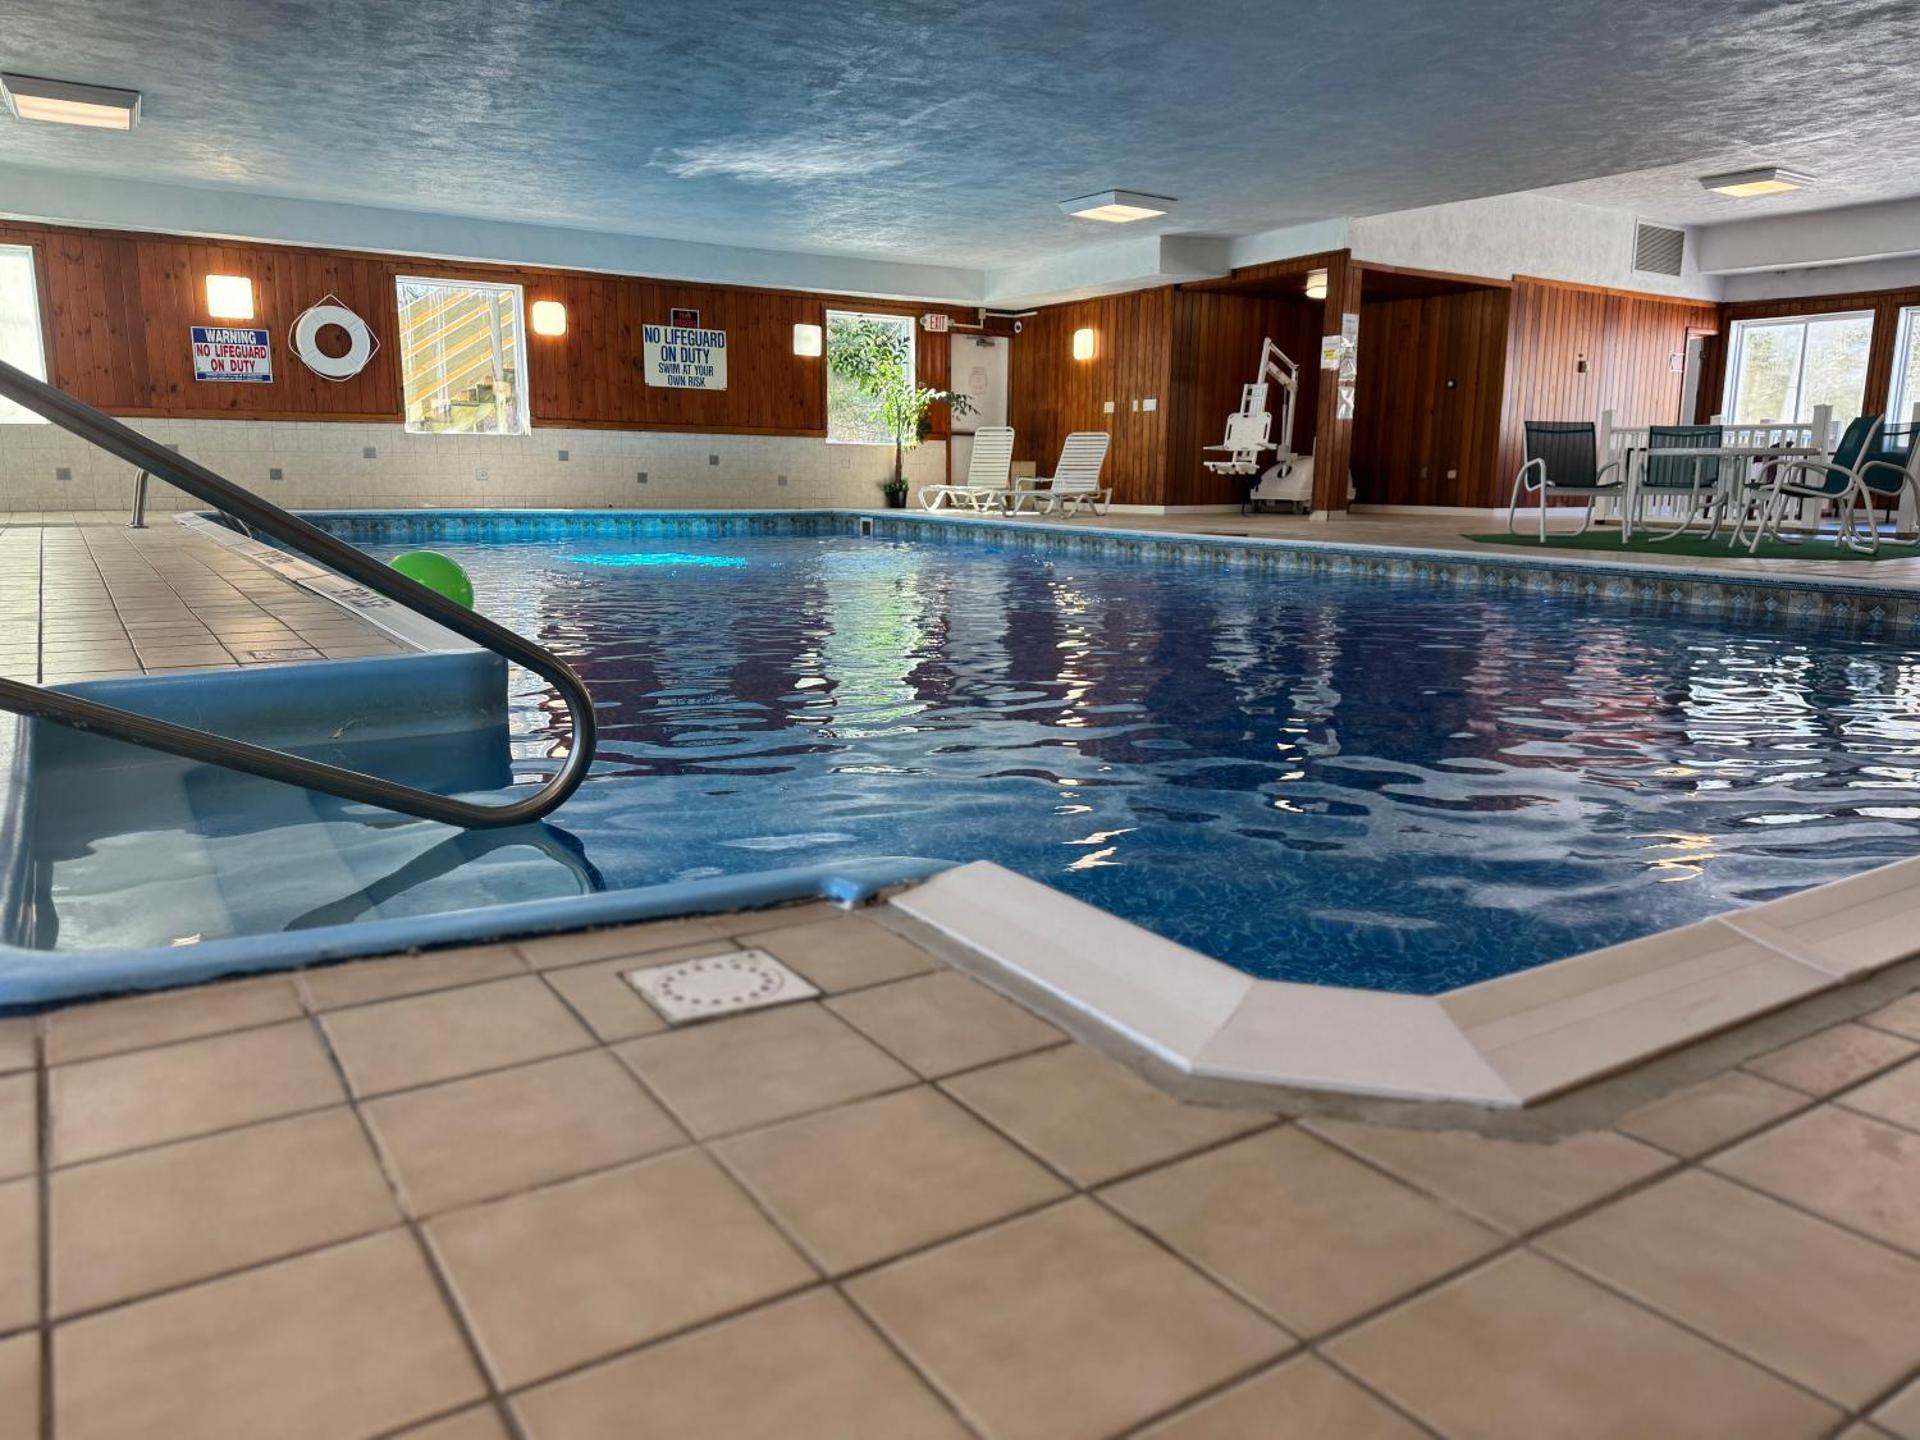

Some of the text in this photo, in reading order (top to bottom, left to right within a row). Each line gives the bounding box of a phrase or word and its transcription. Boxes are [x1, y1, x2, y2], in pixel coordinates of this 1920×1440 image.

[205, 329, 256, 344] WARNING
[645, 327, 725, 348] NO LIFEGUARD
[197, 344, 267, 359] NO LIFEGUARD
[661, 346, 710, 364] ON DUTY
[211, 359, 255, 372] ON DUTY
[659, 362, 714, 376] SWIM AT YOUR
[668, 375, 706, 387] OWN RISK
